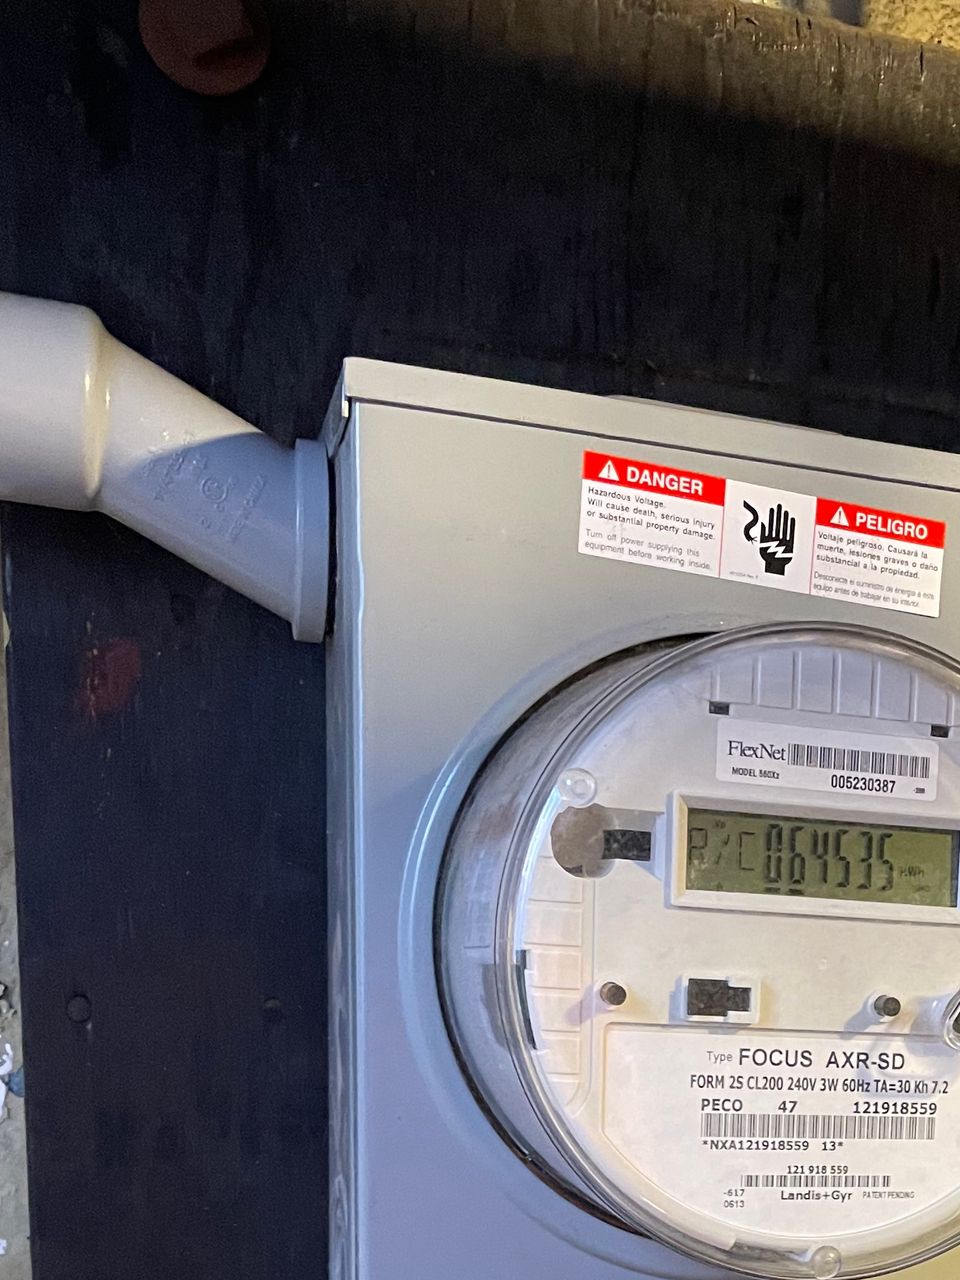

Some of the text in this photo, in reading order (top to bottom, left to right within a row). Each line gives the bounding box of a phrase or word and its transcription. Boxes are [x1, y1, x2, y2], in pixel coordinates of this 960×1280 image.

[627, 466, 703, 495] DANGER
[588, 486, 666, 509] Hazardous Voltage.
[588, 497, 715, 530] Will cause death, serious injury
[599, 511, 643, 526] substantial
[646, 521, 679, 535] property
[683, 527, 716, 541] damage.
[855, 512, 928, 540] PELIGRO
[621, 537, 644, 547] power
[648, 541, 683, 555] supplying
[818, 531, 844, 544] Voltaje
[584, 541, 624, 555] equipment
[628, 548, 652, 559] before
[656, 553, 685, 567] working
[849, 549, 881, 561] lesiones
[883, 557, 909, 568] graves
[728, 740, 786, 761] FlexNet
[731, 766, 757, 778] MODEL
[831, 774, 896, 793] 005230387
[766, 823, 893, 891] 064535
[706, 1048, 905, 1070] Type FOCUS AXR-SD
[690, 1074, 949, 1094] FORM 2S CL200 240V 3W 60Hz TA=30 Kh 7.2
[701, 1098, 937, 1115] PECO 47 121918559
[787, 1165, 849, 1175] 121 918 559
[723, 1188, 745, 1197] -617
[780, 1189, 852, 1203] Landis+Gyr
[723, 1200, 745, 1208] 0613
